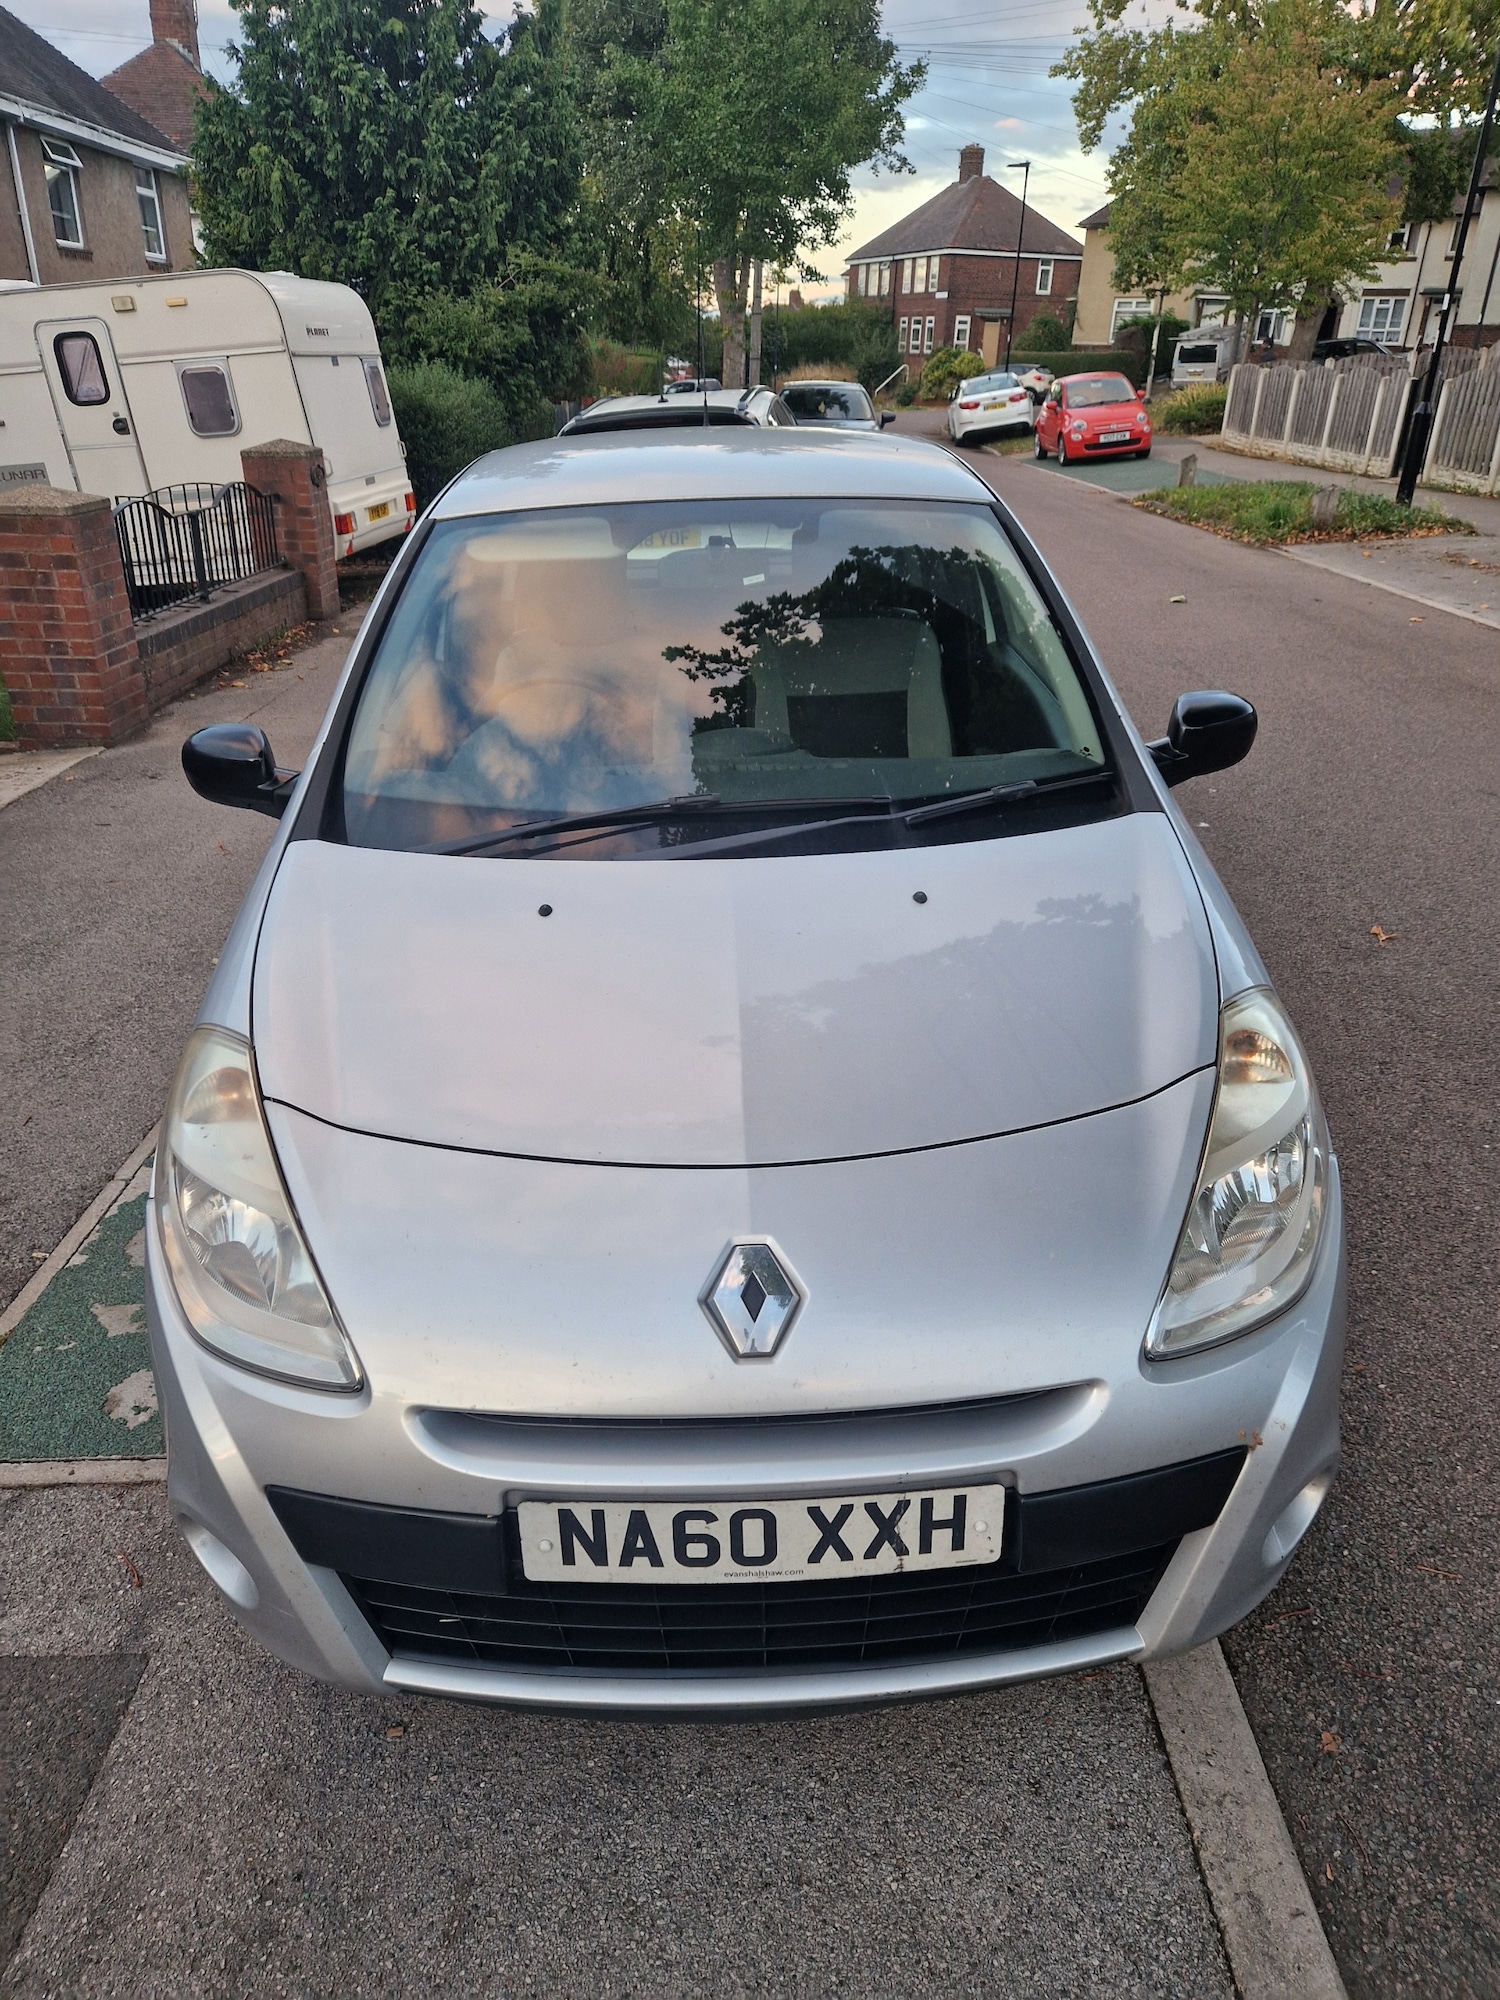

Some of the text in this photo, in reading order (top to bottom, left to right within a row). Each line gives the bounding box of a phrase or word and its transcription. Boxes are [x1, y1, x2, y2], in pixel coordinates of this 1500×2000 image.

[0, 469, 46, 482] UNAR
[557, 1494, 968, 1567] NA60 XXH
[723, 1569, 804, 1578] evanshalshaw.com
